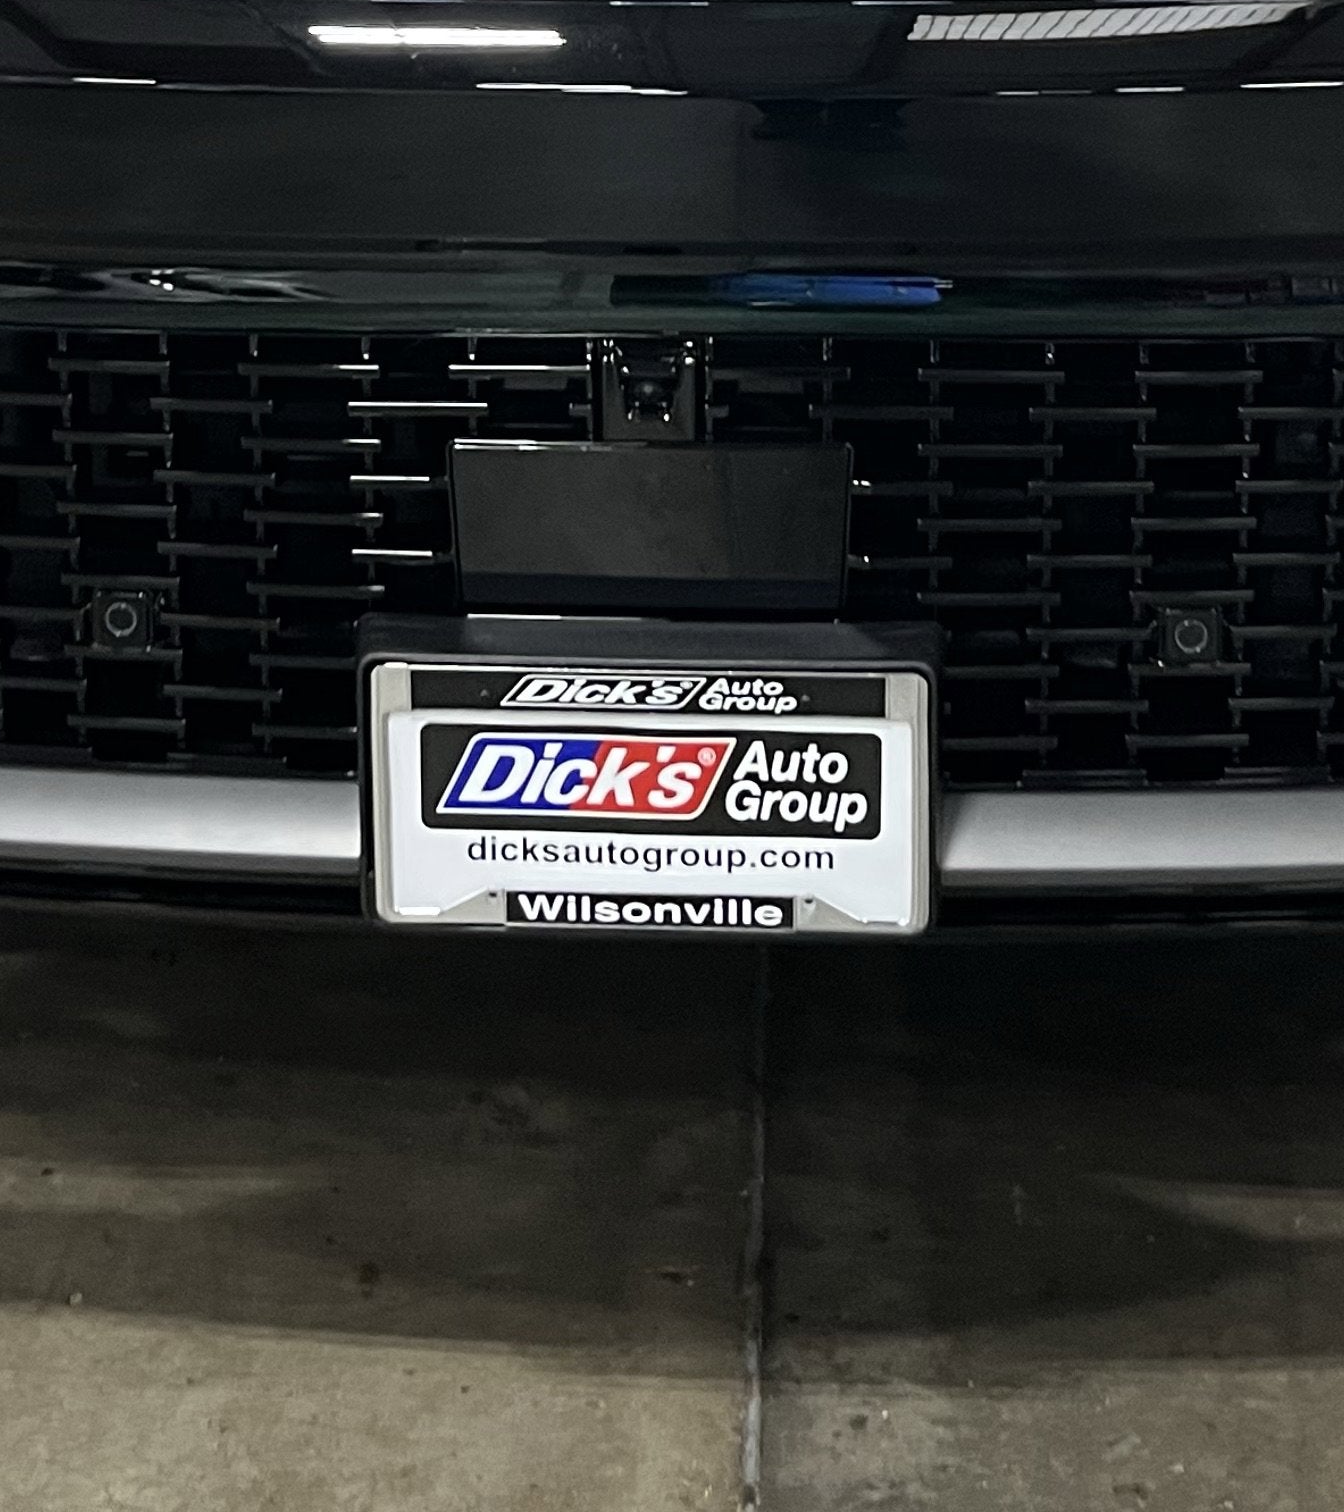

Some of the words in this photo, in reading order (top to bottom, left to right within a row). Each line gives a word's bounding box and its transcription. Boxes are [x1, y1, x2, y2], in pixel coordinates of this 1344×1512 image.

[699, 694, 798, 714] Group
[710, 678, 784, 696] Auto
[457, 744, 700, 809] Dick's
[735, 741, 849, 785] Auto
[725, 780, 868, 831] Group
[467, 834, 836, 873] dicksautogroup.com
[517, 893, 784, 927] Wilsonville
